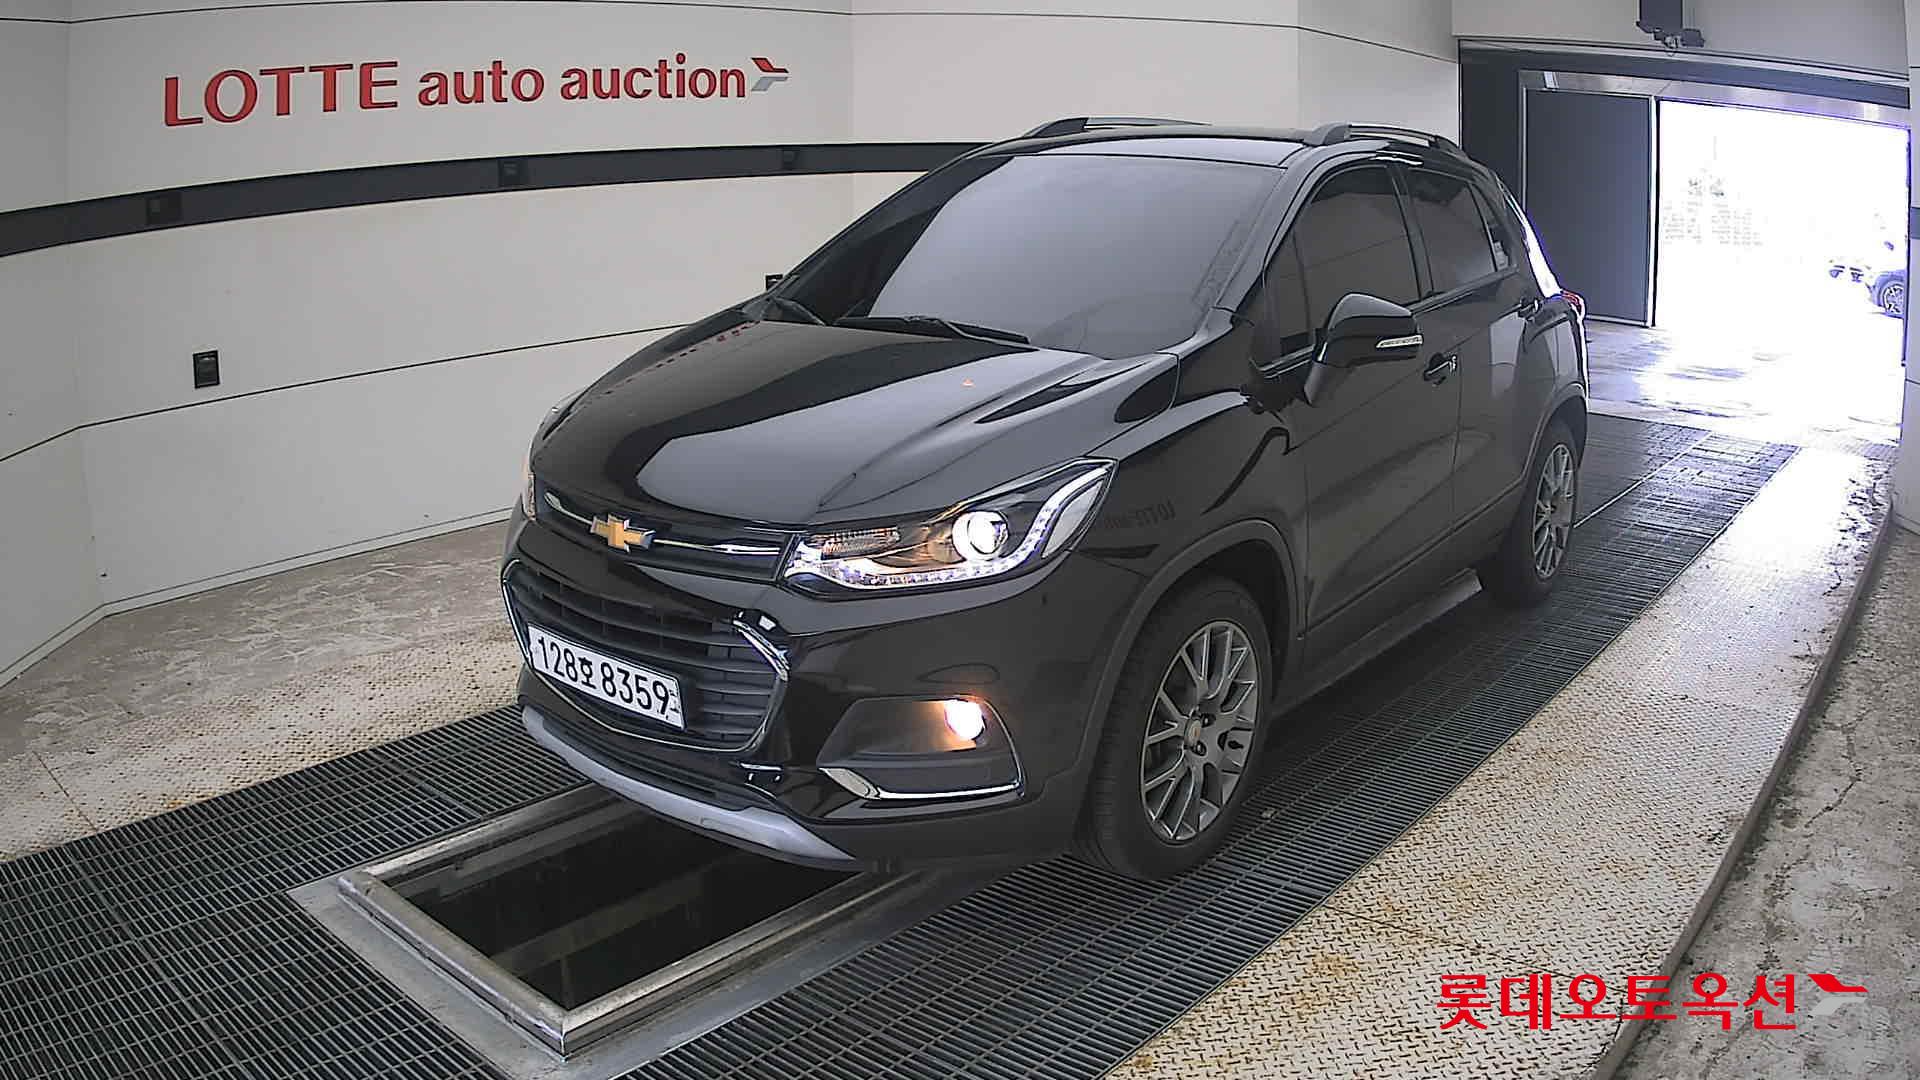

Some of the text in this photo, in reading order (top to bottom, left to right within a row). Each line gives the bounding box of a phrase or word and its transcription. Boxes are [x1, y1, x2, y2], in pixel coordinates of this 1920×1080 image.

[164, 53, 746, 127] LOTTE auto auction
[600, 662, 671, 716] 8359
